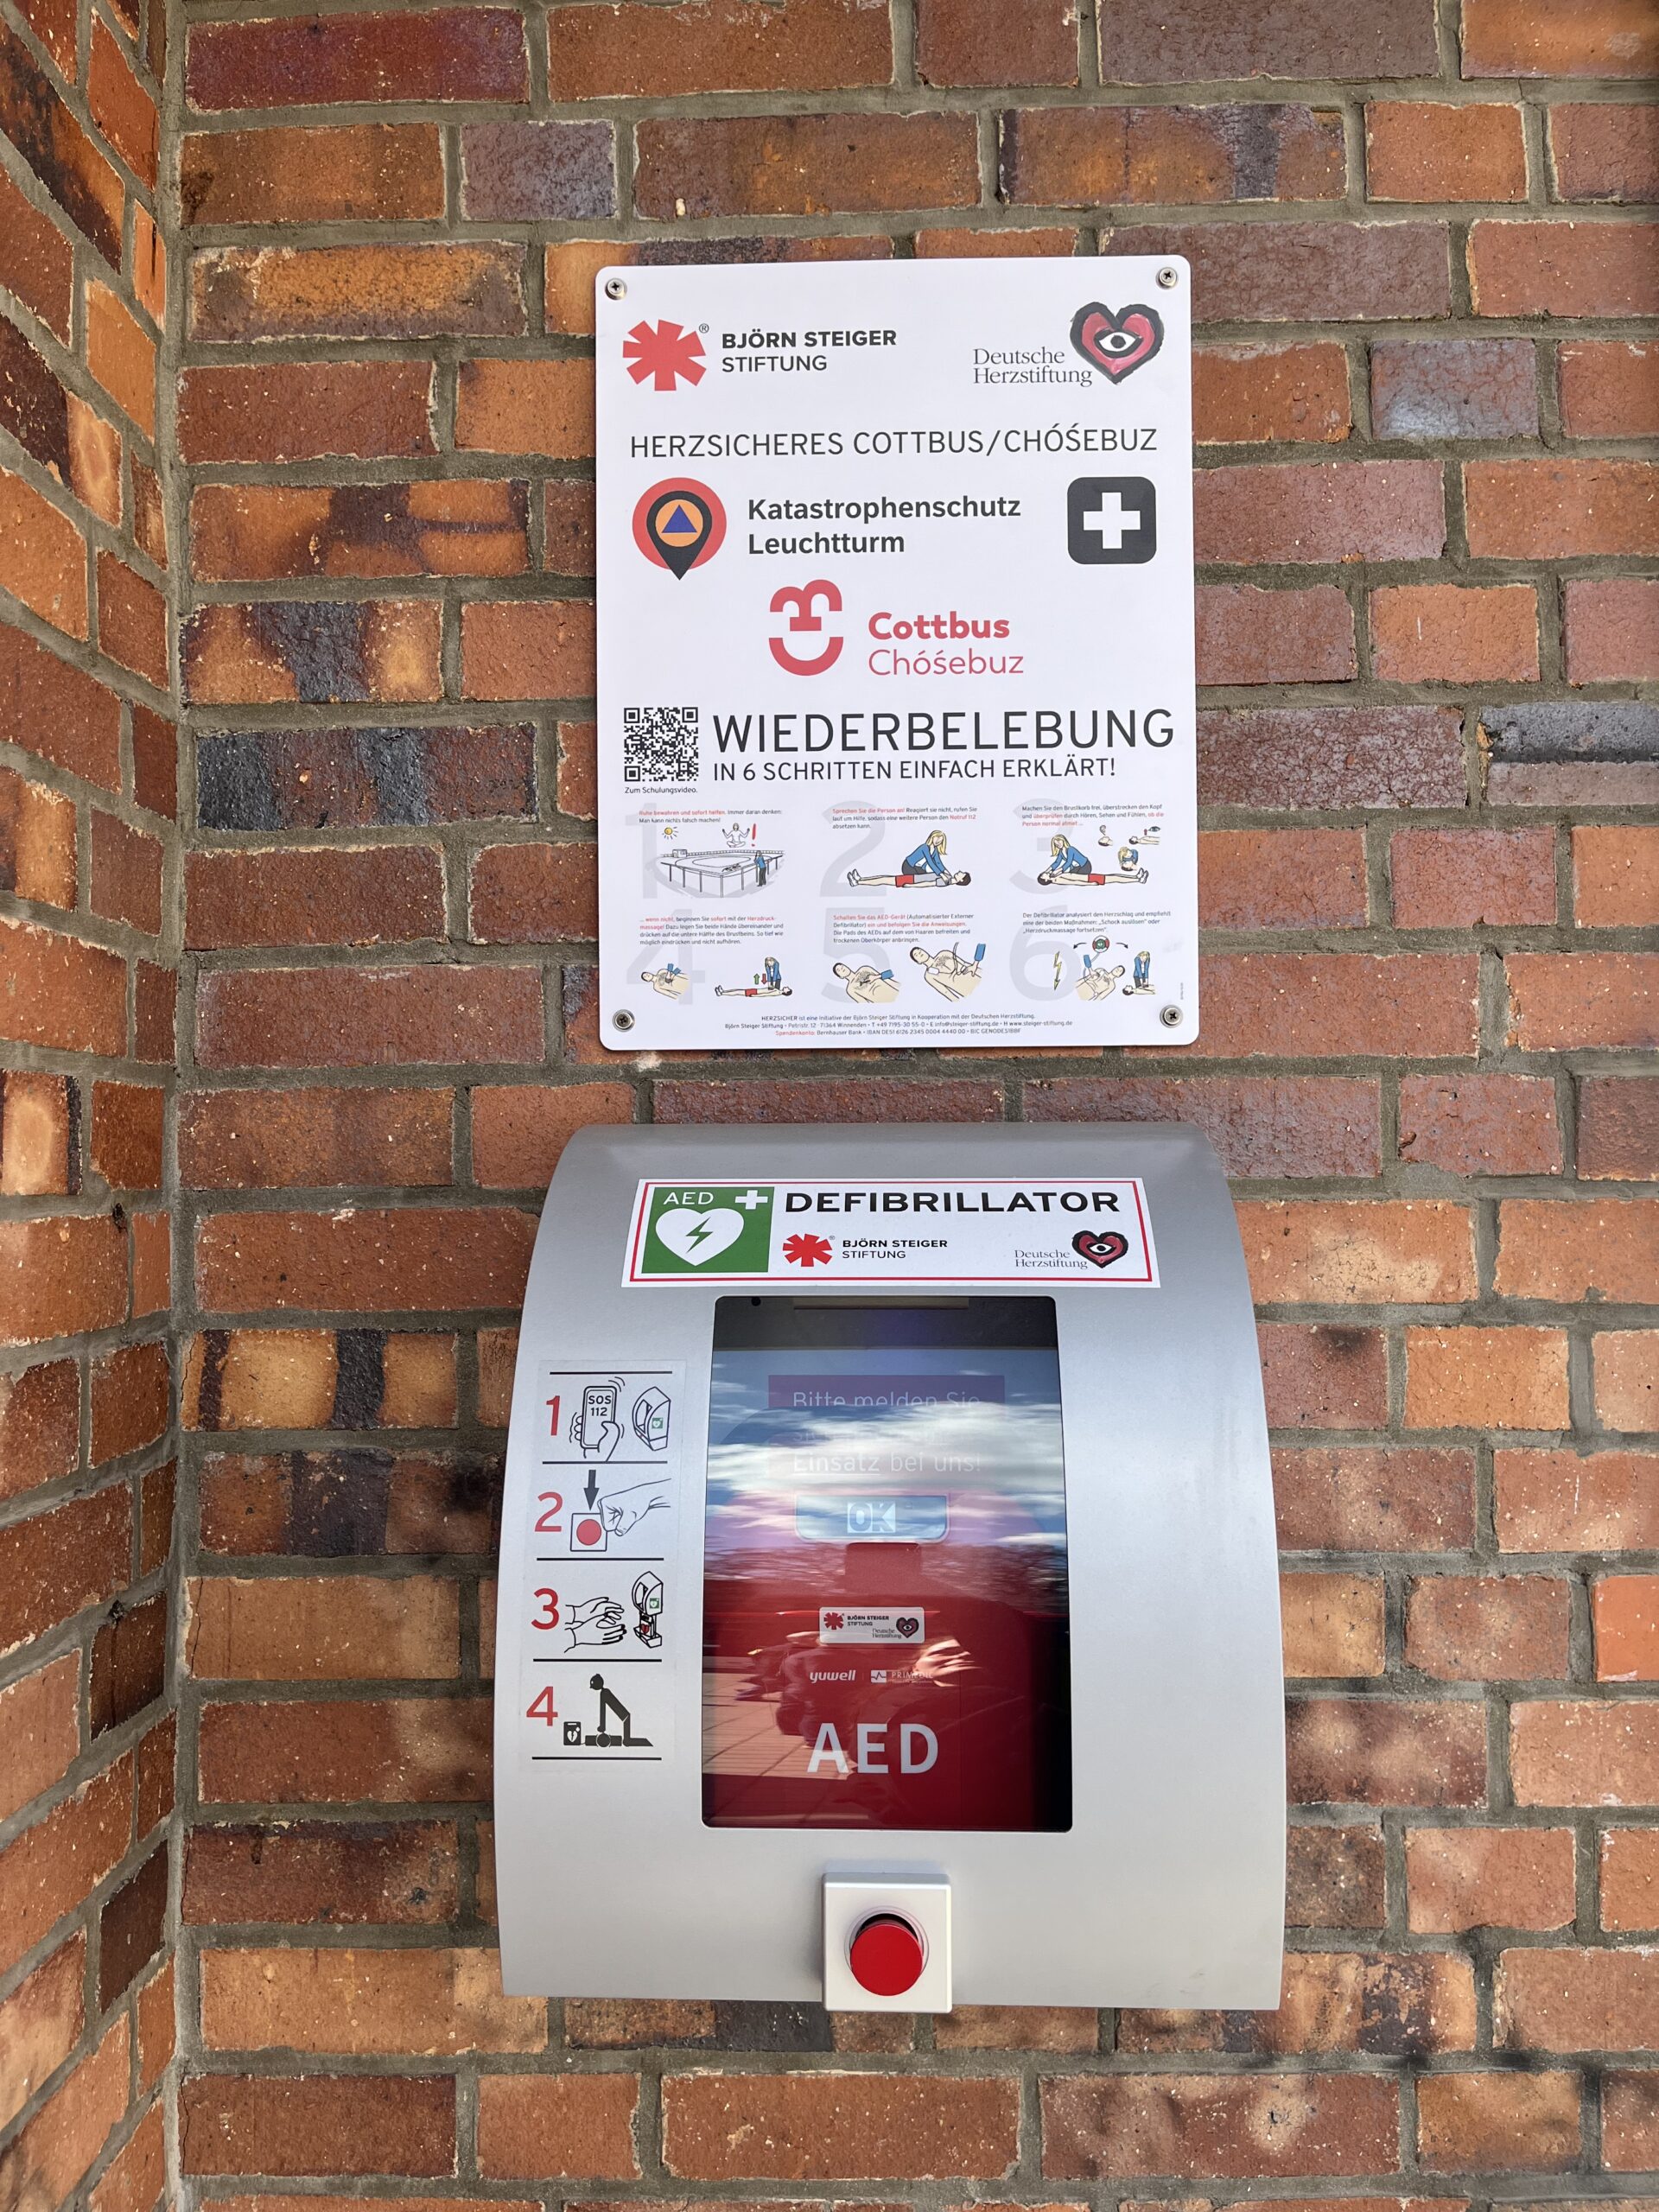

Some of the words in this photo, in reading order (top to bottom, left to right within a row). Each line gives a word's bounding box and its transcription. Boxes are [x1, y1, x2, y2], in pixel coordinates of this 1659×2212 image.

[722, 329, 797, 349] BJÖRN
[804, 330, 896, 346] STEIGER
[721, 354, 828, 373] STIFTUNG
[973, 346, 1065, 365] Deutsche
[973, 366, 1092, 387] Herzstiftung
[632, 433, 842, 457] HERZSICHERES
[854, 423, 1156, 456] COTTBUS/CHÓŚEBUZ
[748, 495, 1021, 524] Katastrophenschutz
[748, 531, 906, 555] Leuchtturm
[868, 611, 1011, 640] Cottbus
[868, 648, 1025, 676] Chóśebuz
[713, 709, 1173, 752] WIEDERBELEBUNG
[715, 763, 734, 780] IN
[743, 763, 755, 780] 6
[764, 761, 891, 780] SCHRITTEN
[900, 760, 994, 779] EINFACH
[1004, 754, 1115, 777] ERKLÄRT!
[642, 786, 698, 795] Schulungsvideo.
[663, 1192, 715, 1205] AED
[785, 1192, 1120, 1212] DEFIBRILLATOR
[843, 1238, 887, 1247] BJÖRN
[1015, 1249, 1070, 1258] Deutsche
[1016, 1258, 1090, 1269] Herzstiftung
[588, 1395, 612, 1405] SOS
[546, 1395, 560, 1436] 1
[590, 1407, 608, 1417] 112
[890, 1452, 924, 1472] bei
[533, 1492, 563, 1532] 2
[848, 1502, 896, 1534] OK
[531, 1587, 560, 1630] 3
[809, 1669, 856, 1683] yuwell
[525, 1686, 558, 1726] 4
[807, 1722, 938, 1774] AED
